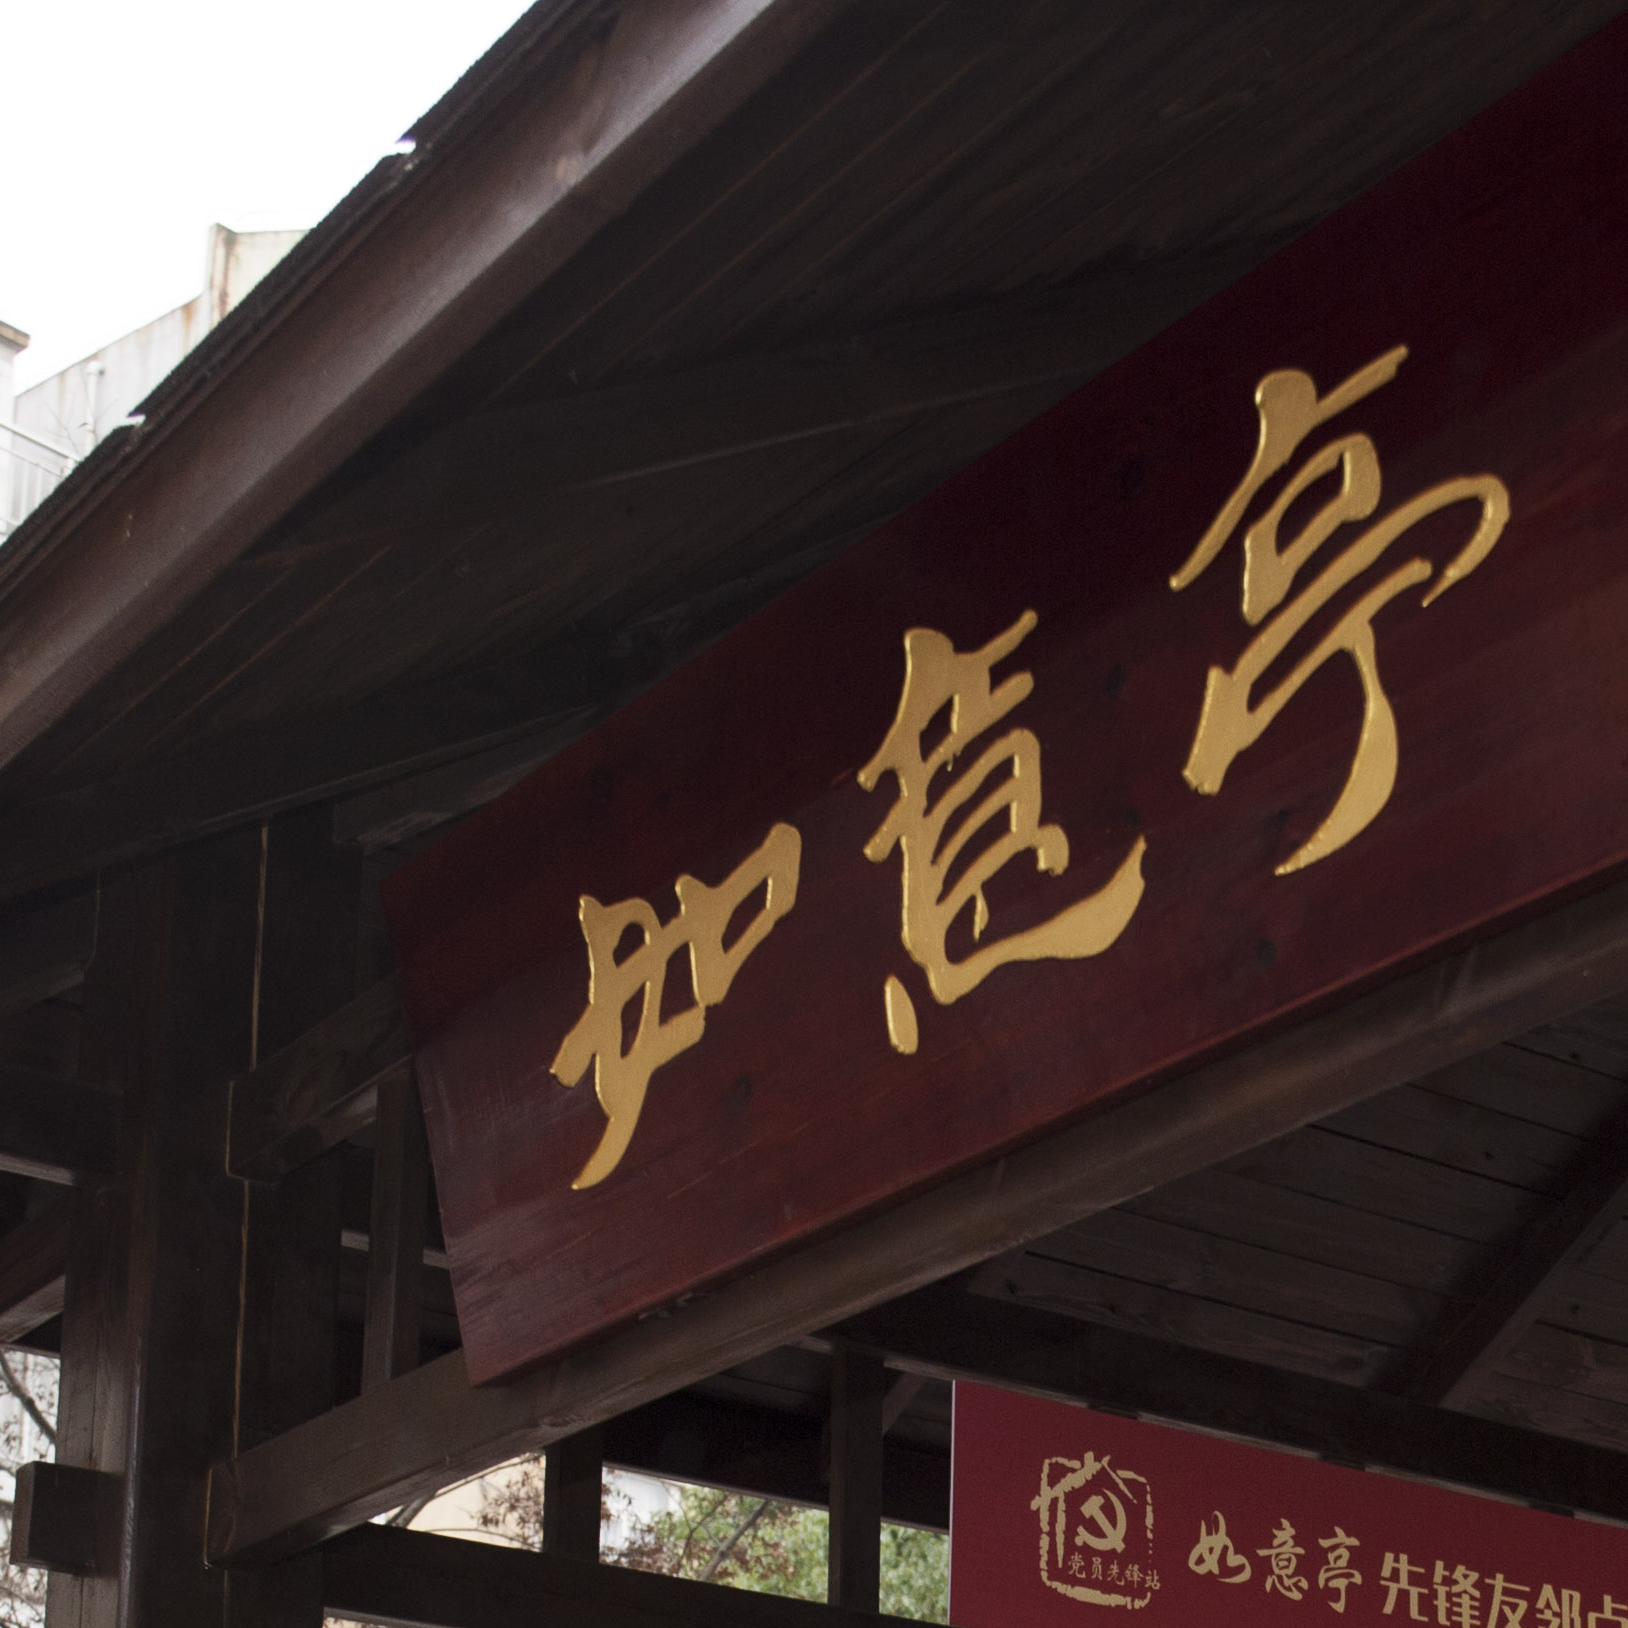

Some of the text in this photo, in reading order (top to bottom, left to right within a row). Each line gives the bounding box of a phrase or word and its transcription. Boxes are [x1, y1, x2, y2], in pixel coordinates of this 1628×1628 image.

[549, 347, 1510, 1191] 如意亭
[1068, 1551, 1161, 1590] 党员先锋站
